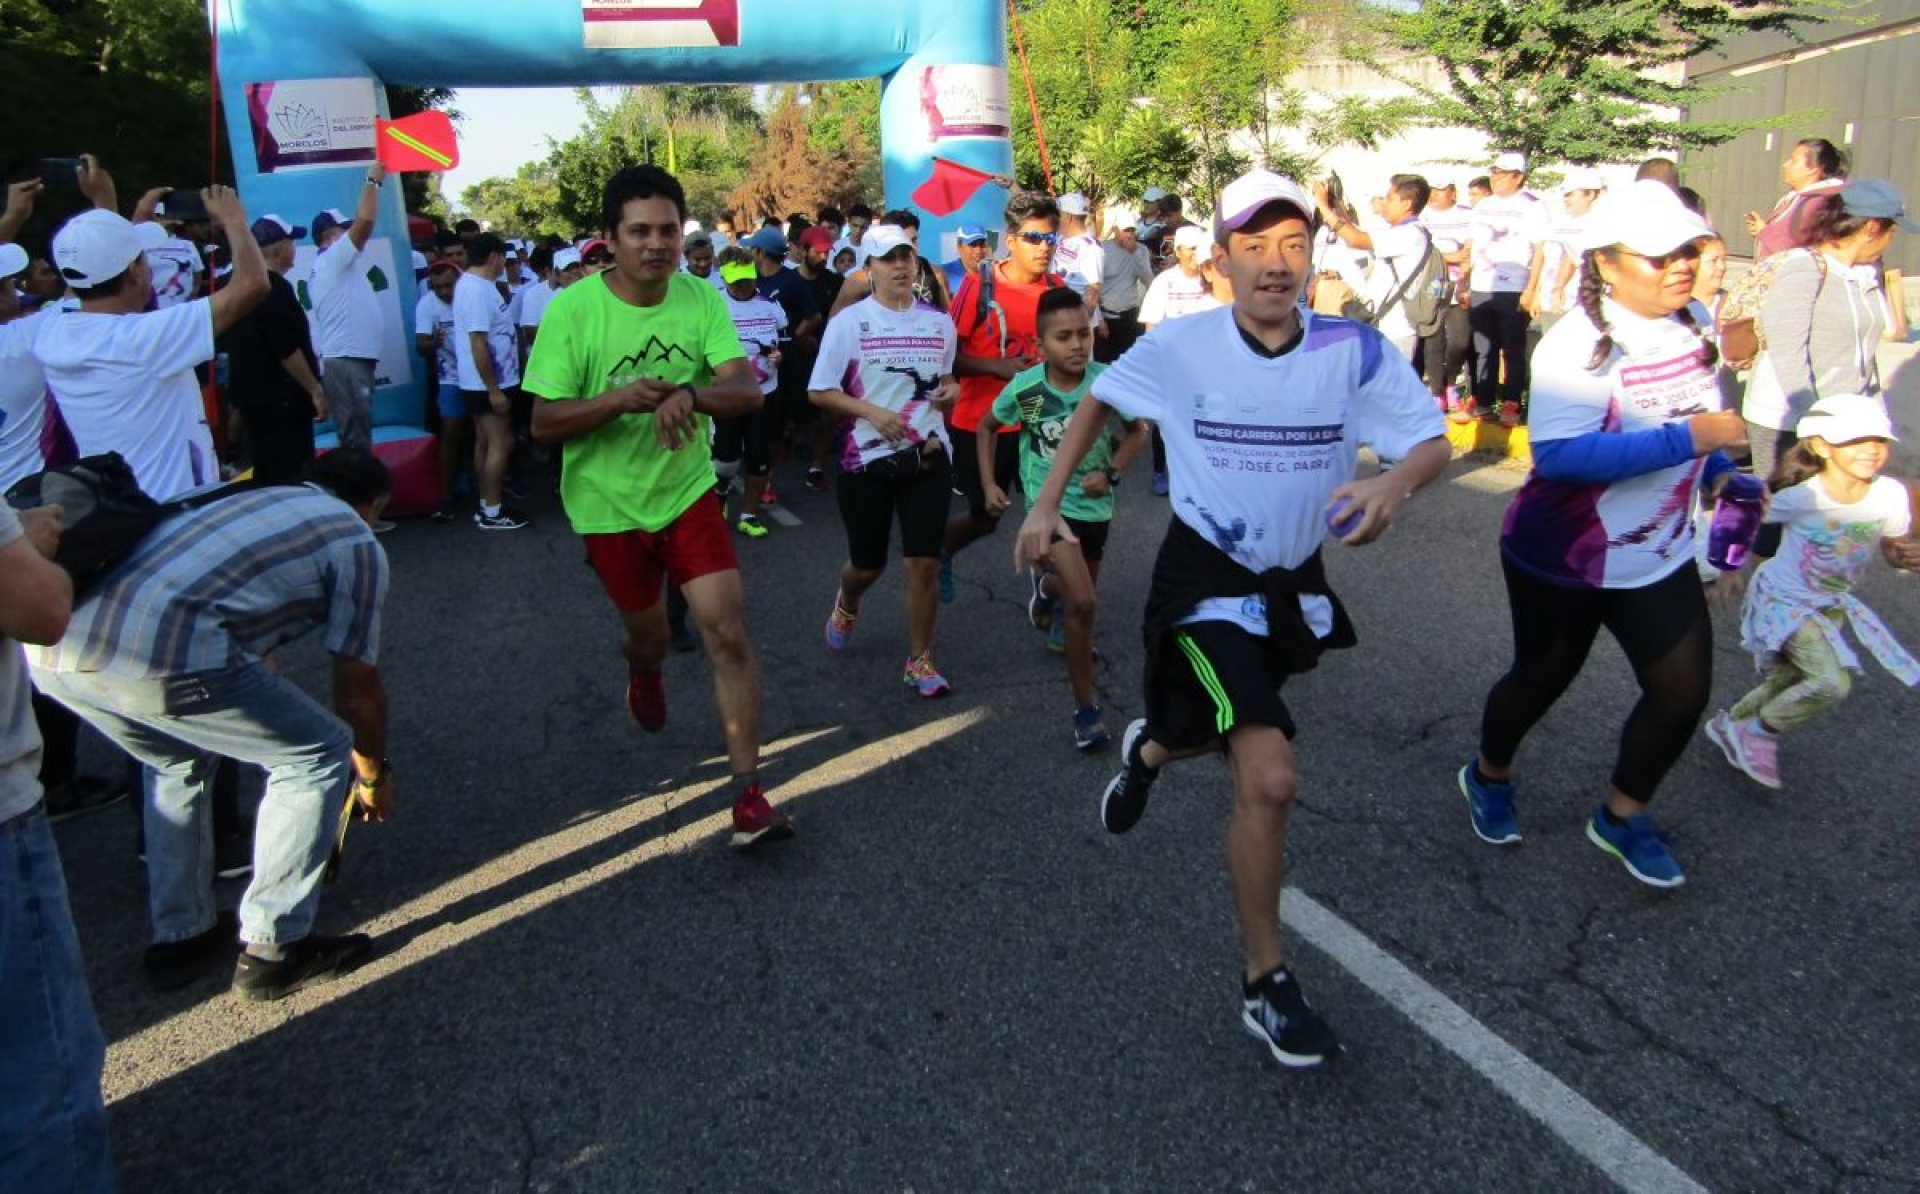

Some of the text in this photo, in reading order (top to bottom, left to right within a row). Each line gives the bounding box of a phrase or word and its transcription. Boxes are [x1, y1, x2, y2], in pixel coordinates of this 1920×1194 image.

[280, 139, 327, 149] MORELOS
[1197, 425, 1232, 439] PRIMER
[1233, 428, 1284, 441] CARRERA
[1285, 430, 1307, 442] POR
[1308, 430, 1321, 441] LA
